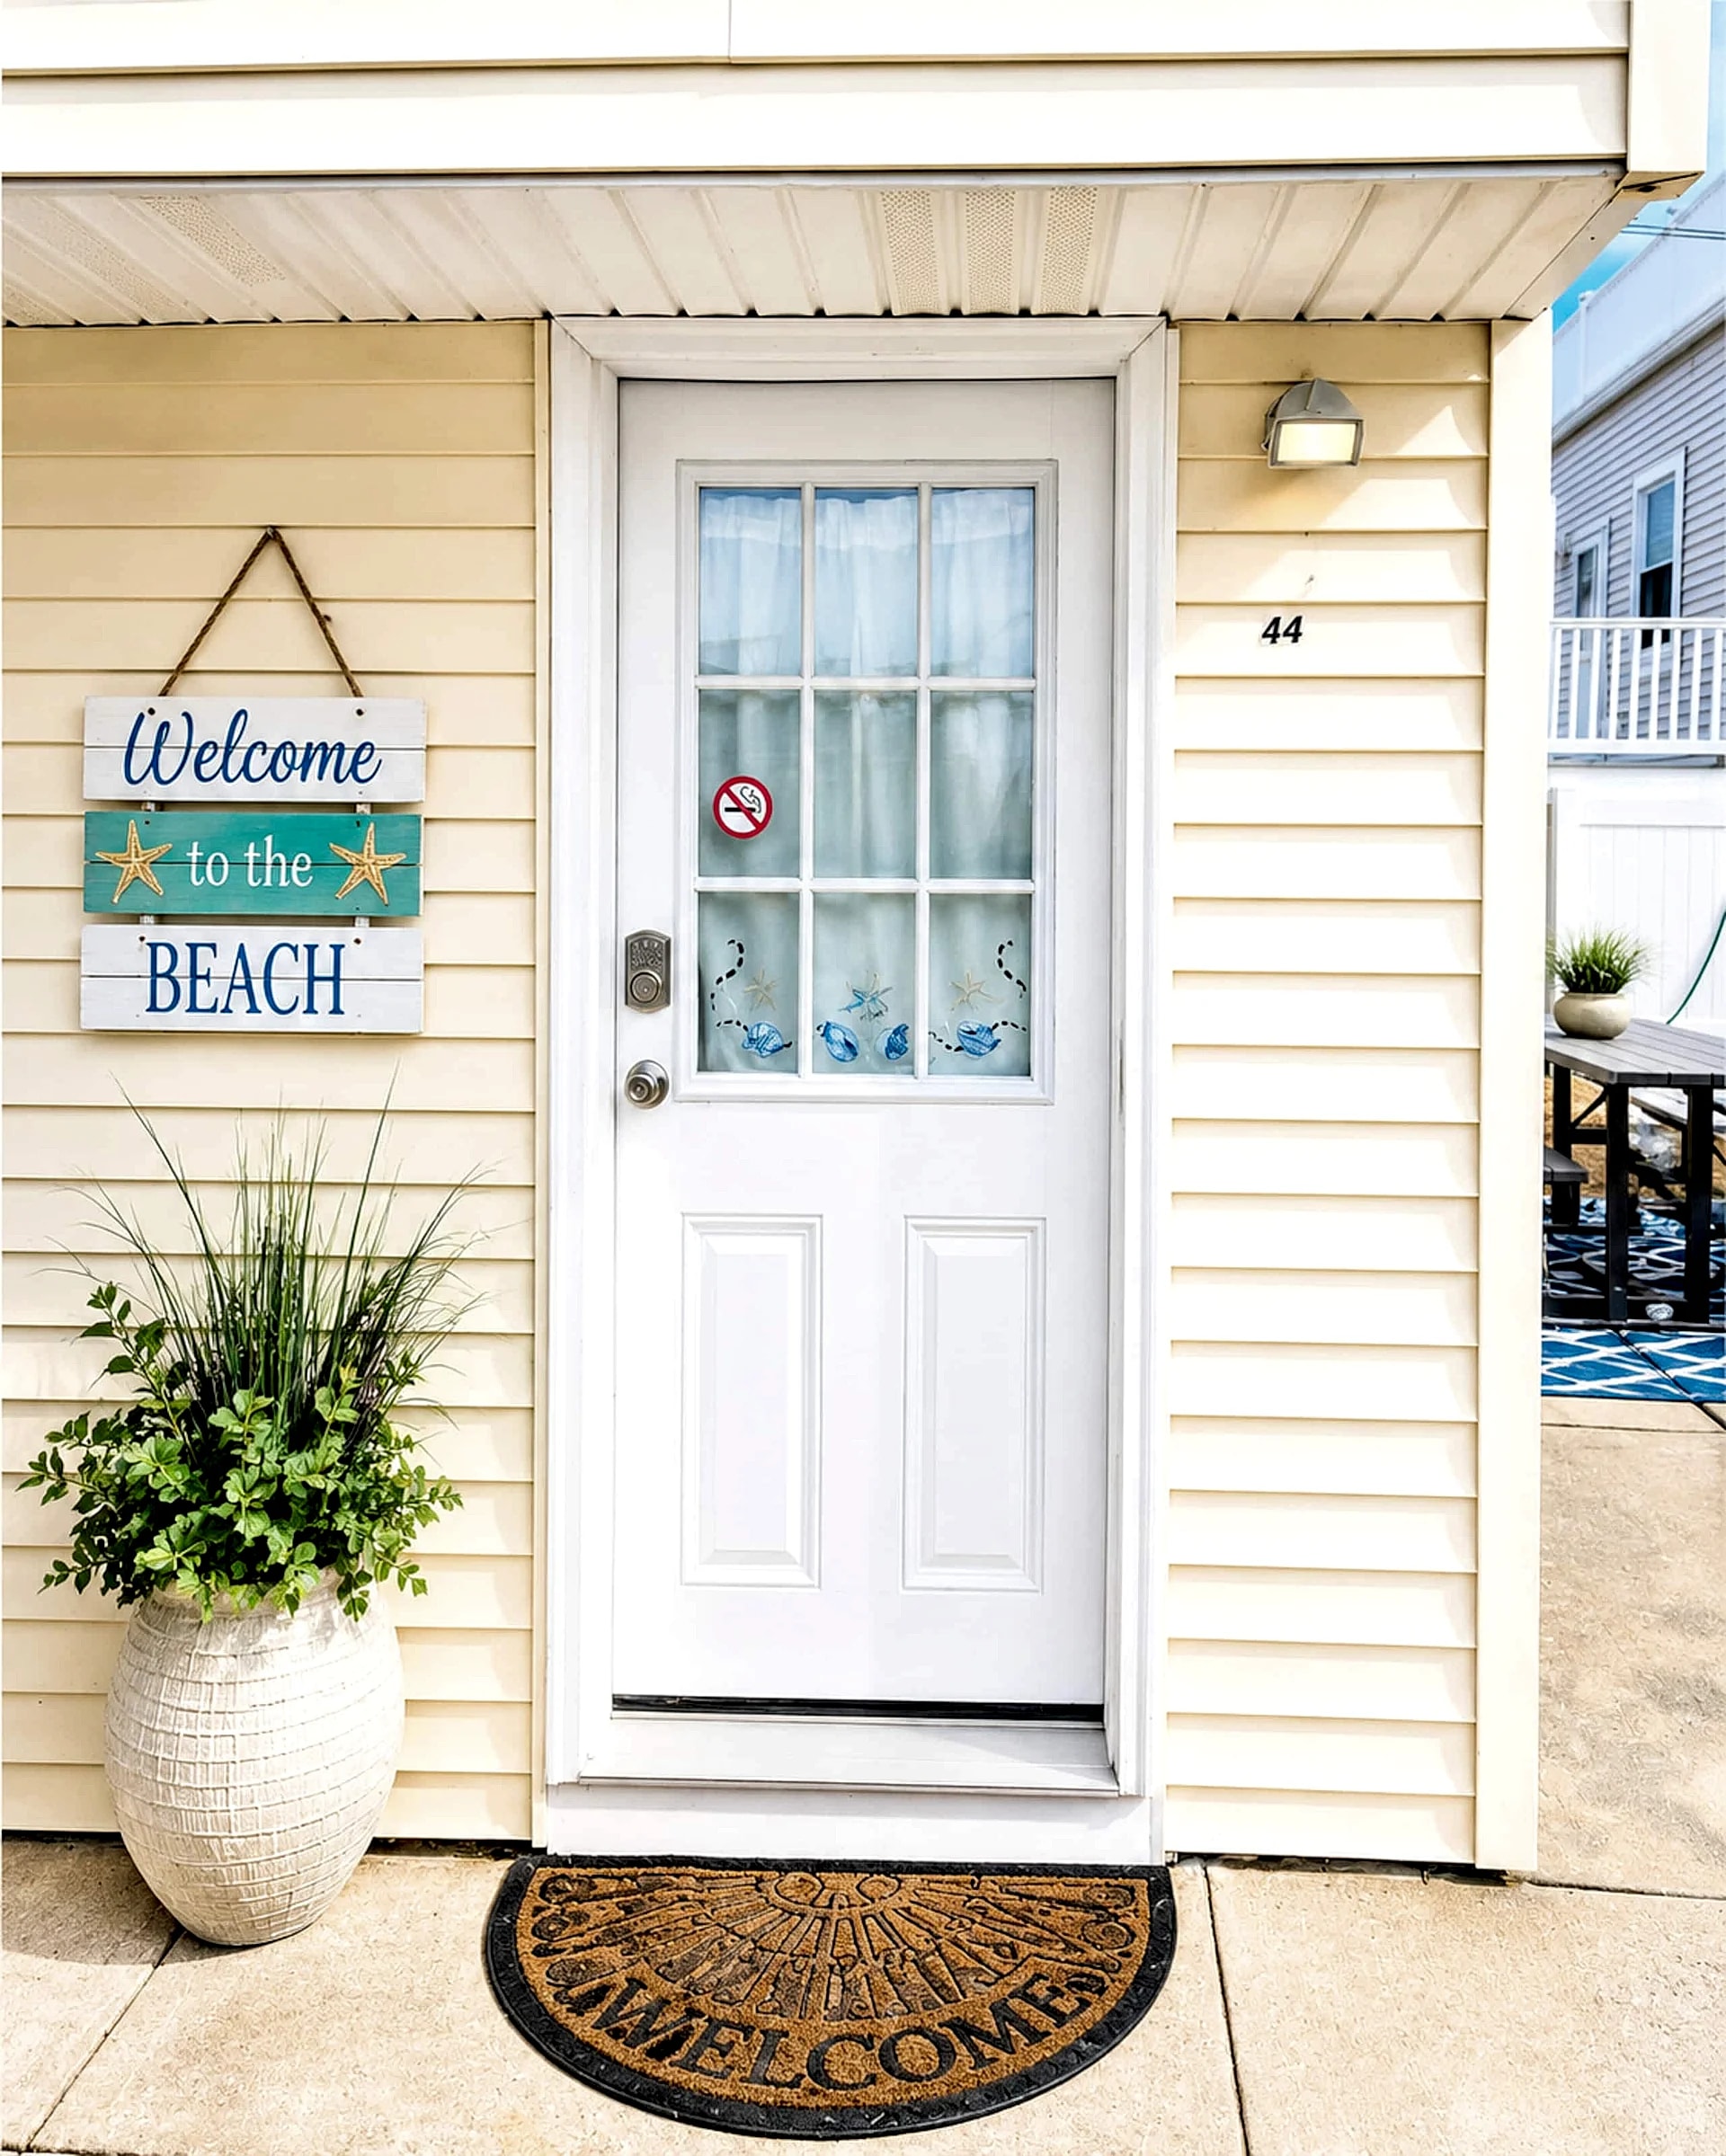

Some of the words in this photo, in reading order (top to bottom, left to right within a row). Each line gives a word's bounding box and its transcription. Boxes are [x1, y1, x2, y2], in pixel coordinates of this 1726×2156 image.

[1261, 615, 1303, 644] 44
[123, 708, 383, 786] Welcome
[186, 840, 230, 887] to
[243, 834, 314, 888] the
[145, 941, 346, 1016] BEACH
[591, 1974, 1092, 2091] WELCOME
